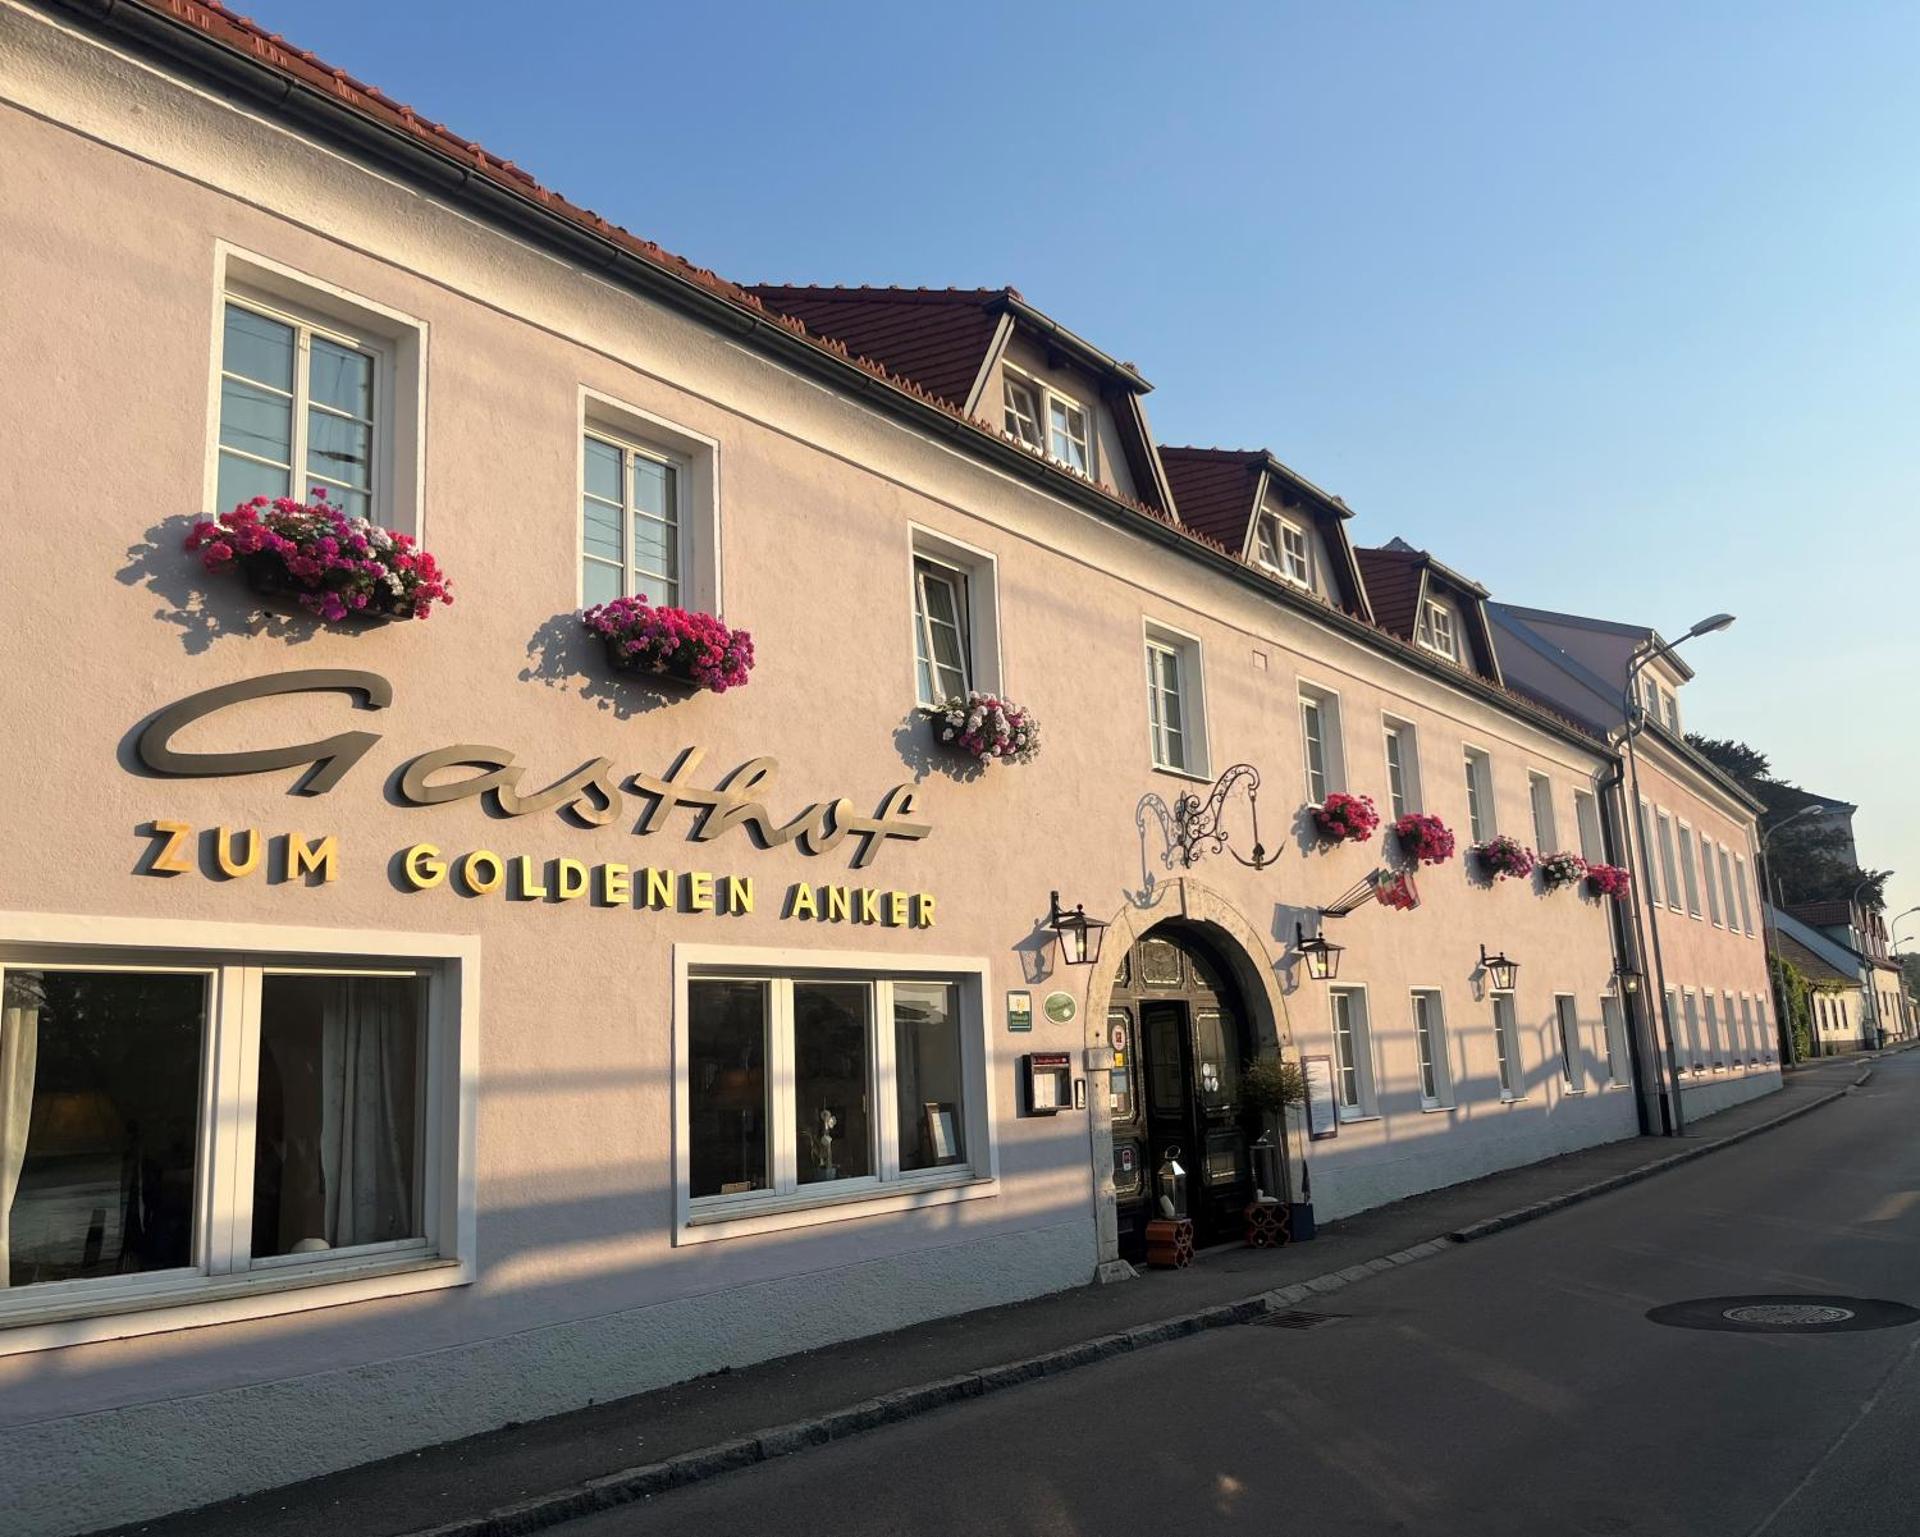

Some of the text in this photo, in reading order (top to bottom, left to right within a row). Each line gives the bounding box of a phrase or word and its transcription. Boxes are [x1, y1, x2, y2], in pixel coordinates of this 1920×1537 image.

[139, 669, 932, 867] Gasthof
[152, 820, 936, 927] ZUM GOLDENEN ANKER
